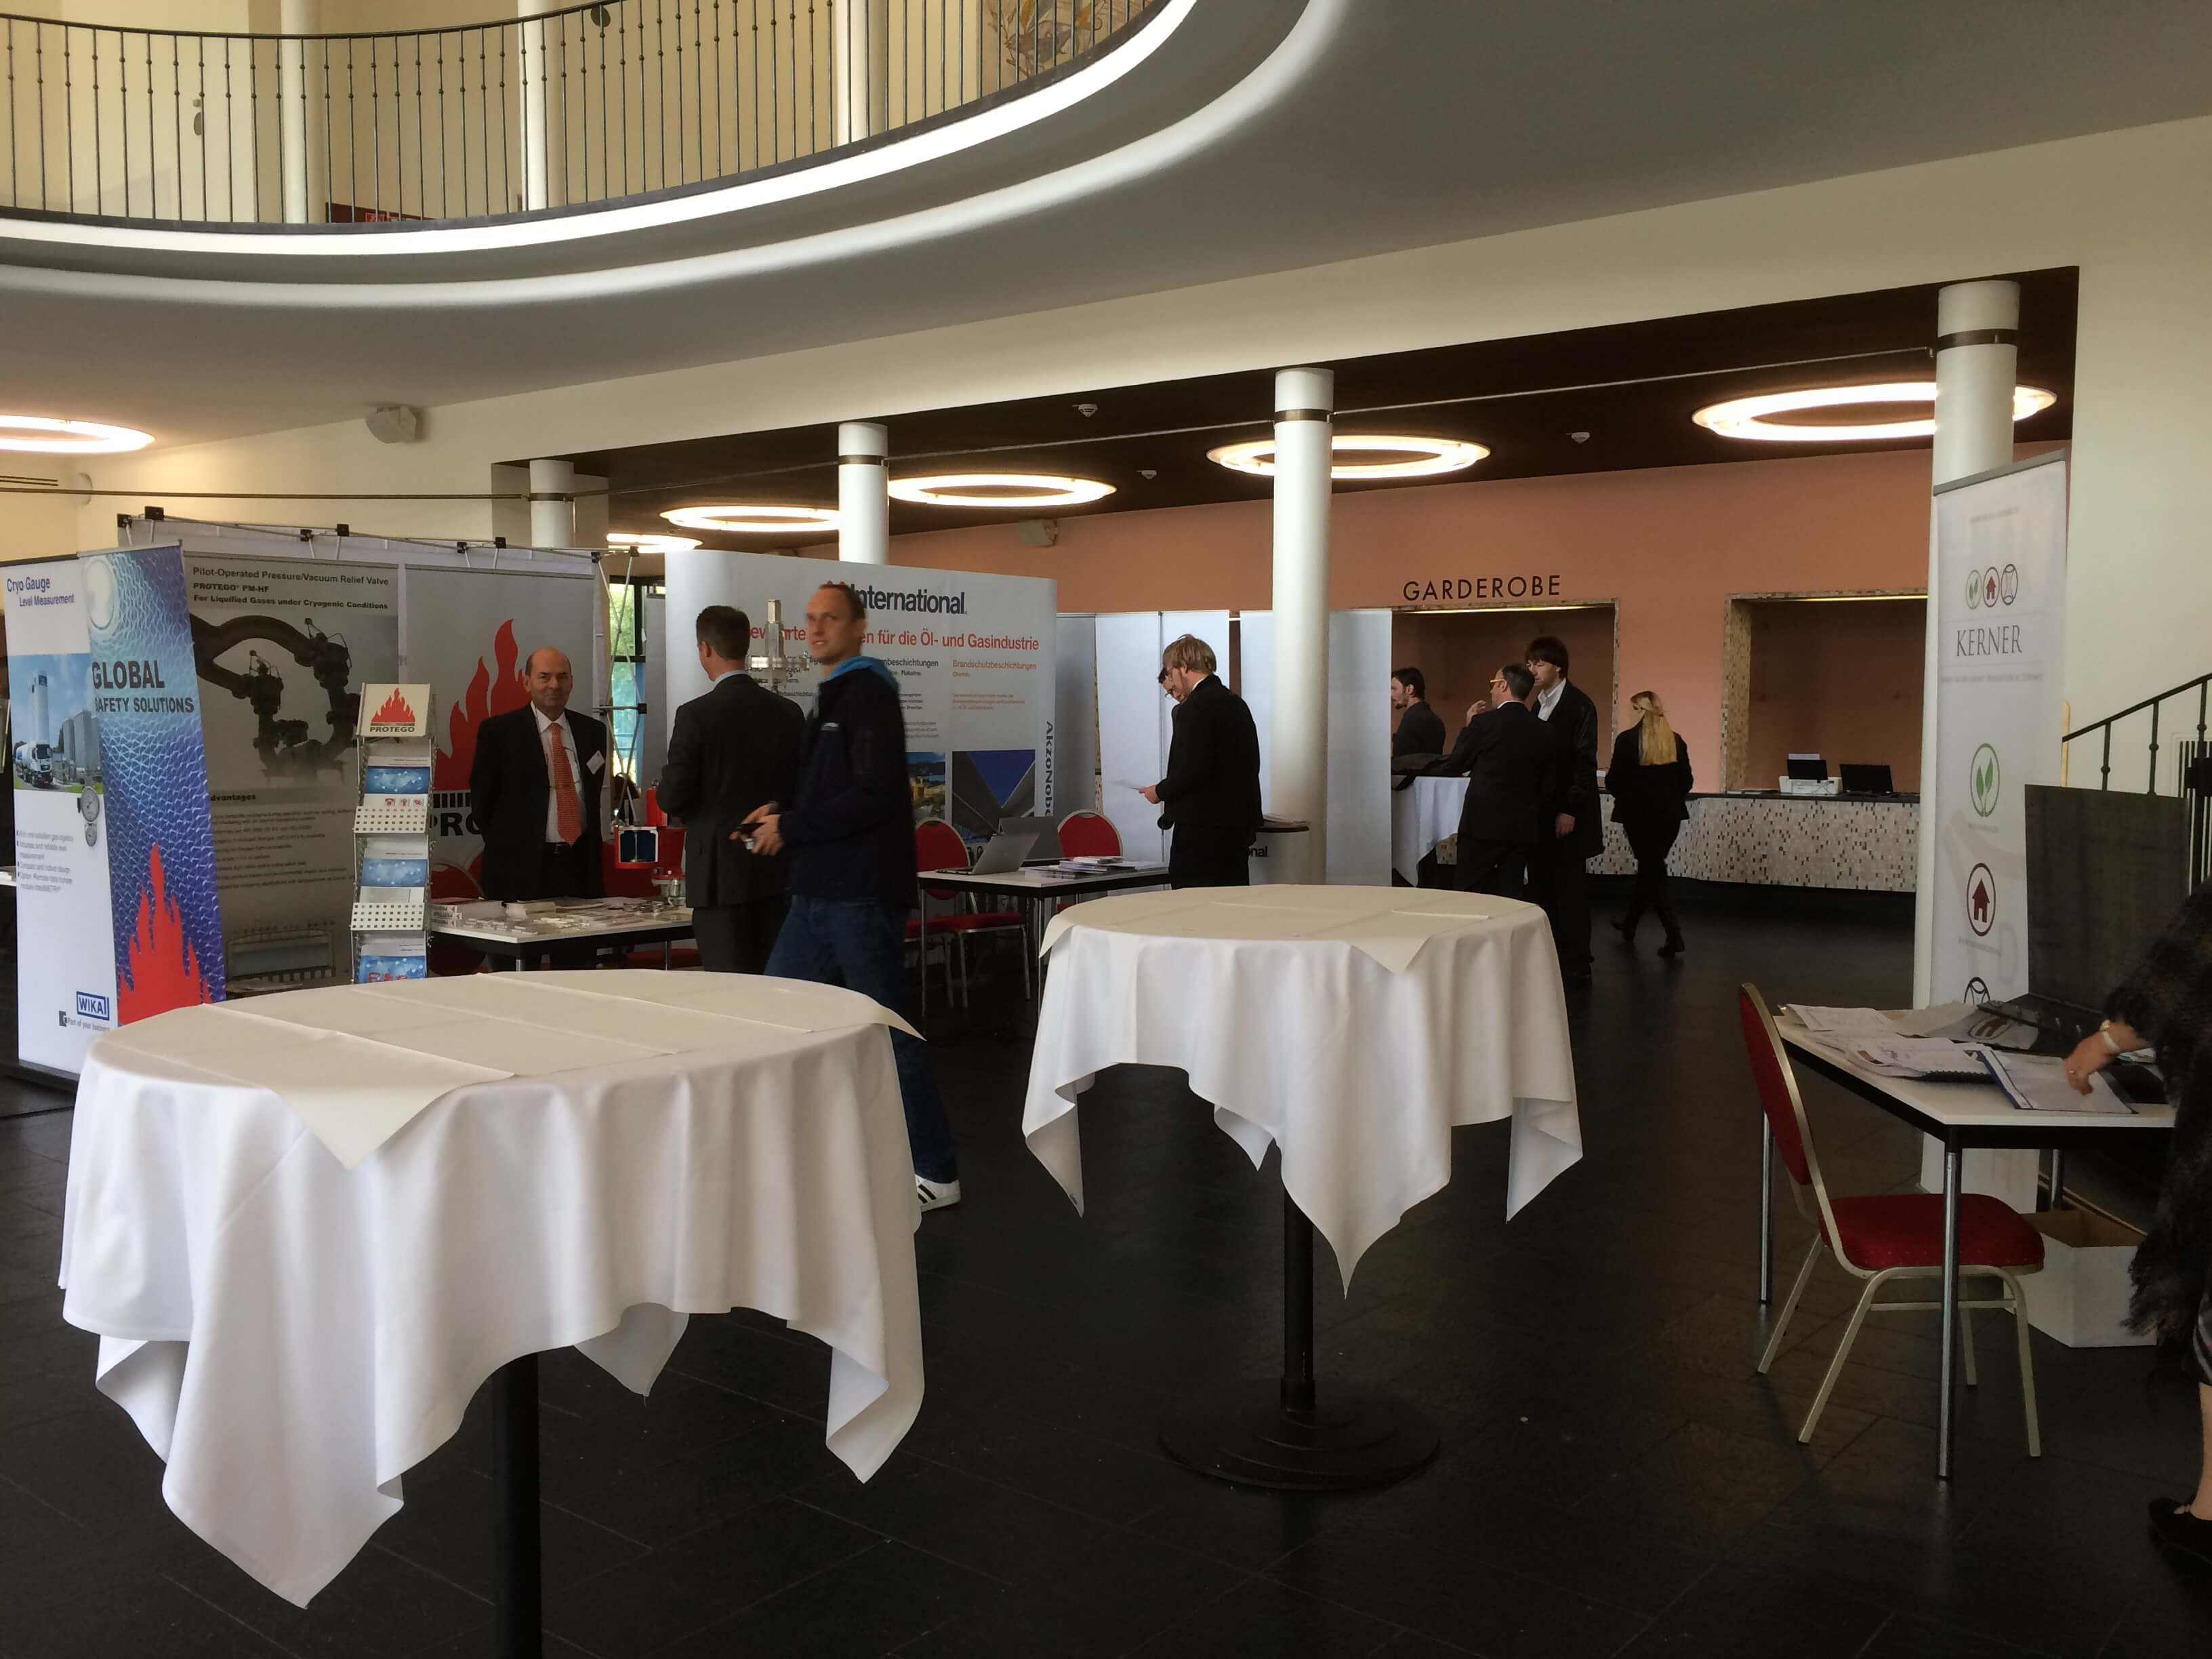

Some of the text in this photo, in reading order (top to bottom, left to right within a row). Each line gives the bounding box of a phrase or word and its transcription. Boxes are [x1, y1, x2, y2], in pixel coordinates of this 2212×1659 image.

[7, 576, 50, 594] Cryo Gauge
[193, 567, 389, 586] Pilot-Operated Pressure/Vacuum Relief Valve
[1403, 575, 1560, 601] GARDEROBE
[19, 594, 75, 607] Level Measurement
[303, 599, 344, 608] Cryogenic
[346, 601, 388, 609] Conditions
[878, 629, 895, 644] für
[898, 630, 917, 646] die
[920, 628, 939, 646] Öl-
[942, 633, 964, 647] und
[968, 633, 1039, 651] Gasindustrie
[1956, 624, 2023, 657] KERNER
[91, 659, 165, 689] GLOBAL
[133, 697, 195, 714] SOLUTIONS
[369, 725, 415, 733] PROTEGO
[1044, 720, 1054, 817] AkzoNobe
[210, 793, 256, 802] dvantages
[79, 996, 104, 1015] WIKA
